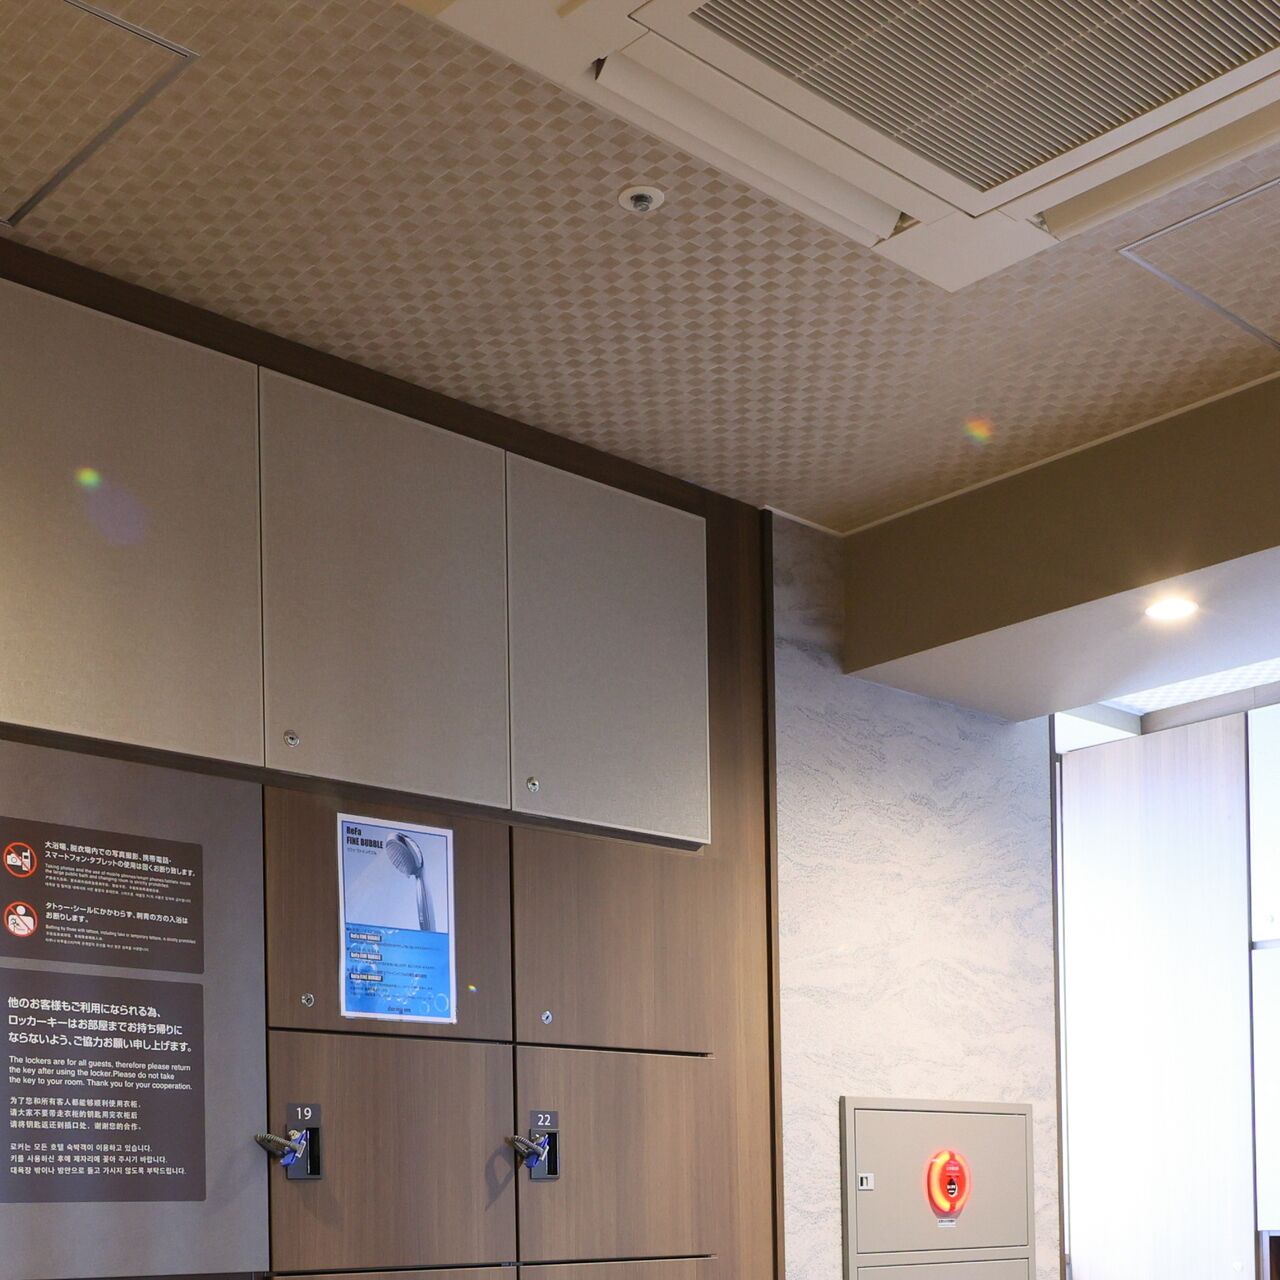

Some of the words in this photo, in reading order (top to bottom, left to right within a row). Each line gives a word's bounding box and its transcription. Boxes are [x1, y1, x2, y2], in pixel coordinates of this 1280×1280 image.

[346, 826, 362, 836] ReFa
[346, 836, 360, 845] FINE
[360, 838, 383, 849] BUBBLE
[8, 996, 161, 1018] 他のお客様もご利用になられる為、
[8, 1015, 183, 1035] ロッカーキーはお部屋までお持ち帰りに
[8, 1032, 192, 1053] ならないよう、ご協力お願い申し上げます。
[9, 1055, 23, 1063] The
[25, 1057, 51, 1065] lockers
[67, 1058, 76, 1066] for
[88, 1061, 114, 1069] guests,
[115, 1061, 146, 1069] therefore
[147, 1062, 170, 1071] please
[22, 1066, 36, 1075] key
[37, 1067, 54, 1075] after
[56, 1068, 76, 1077] using
[137, 1071, 146, 1079] do
[22, 1076, 36, 1085] key
[86, 1079, 109, 1087] Thank
[151, 1082, 193, 1090] cooperation.
[296, 1107, 312, 1120] 19
[537, 1114, 551, 1126] 22
